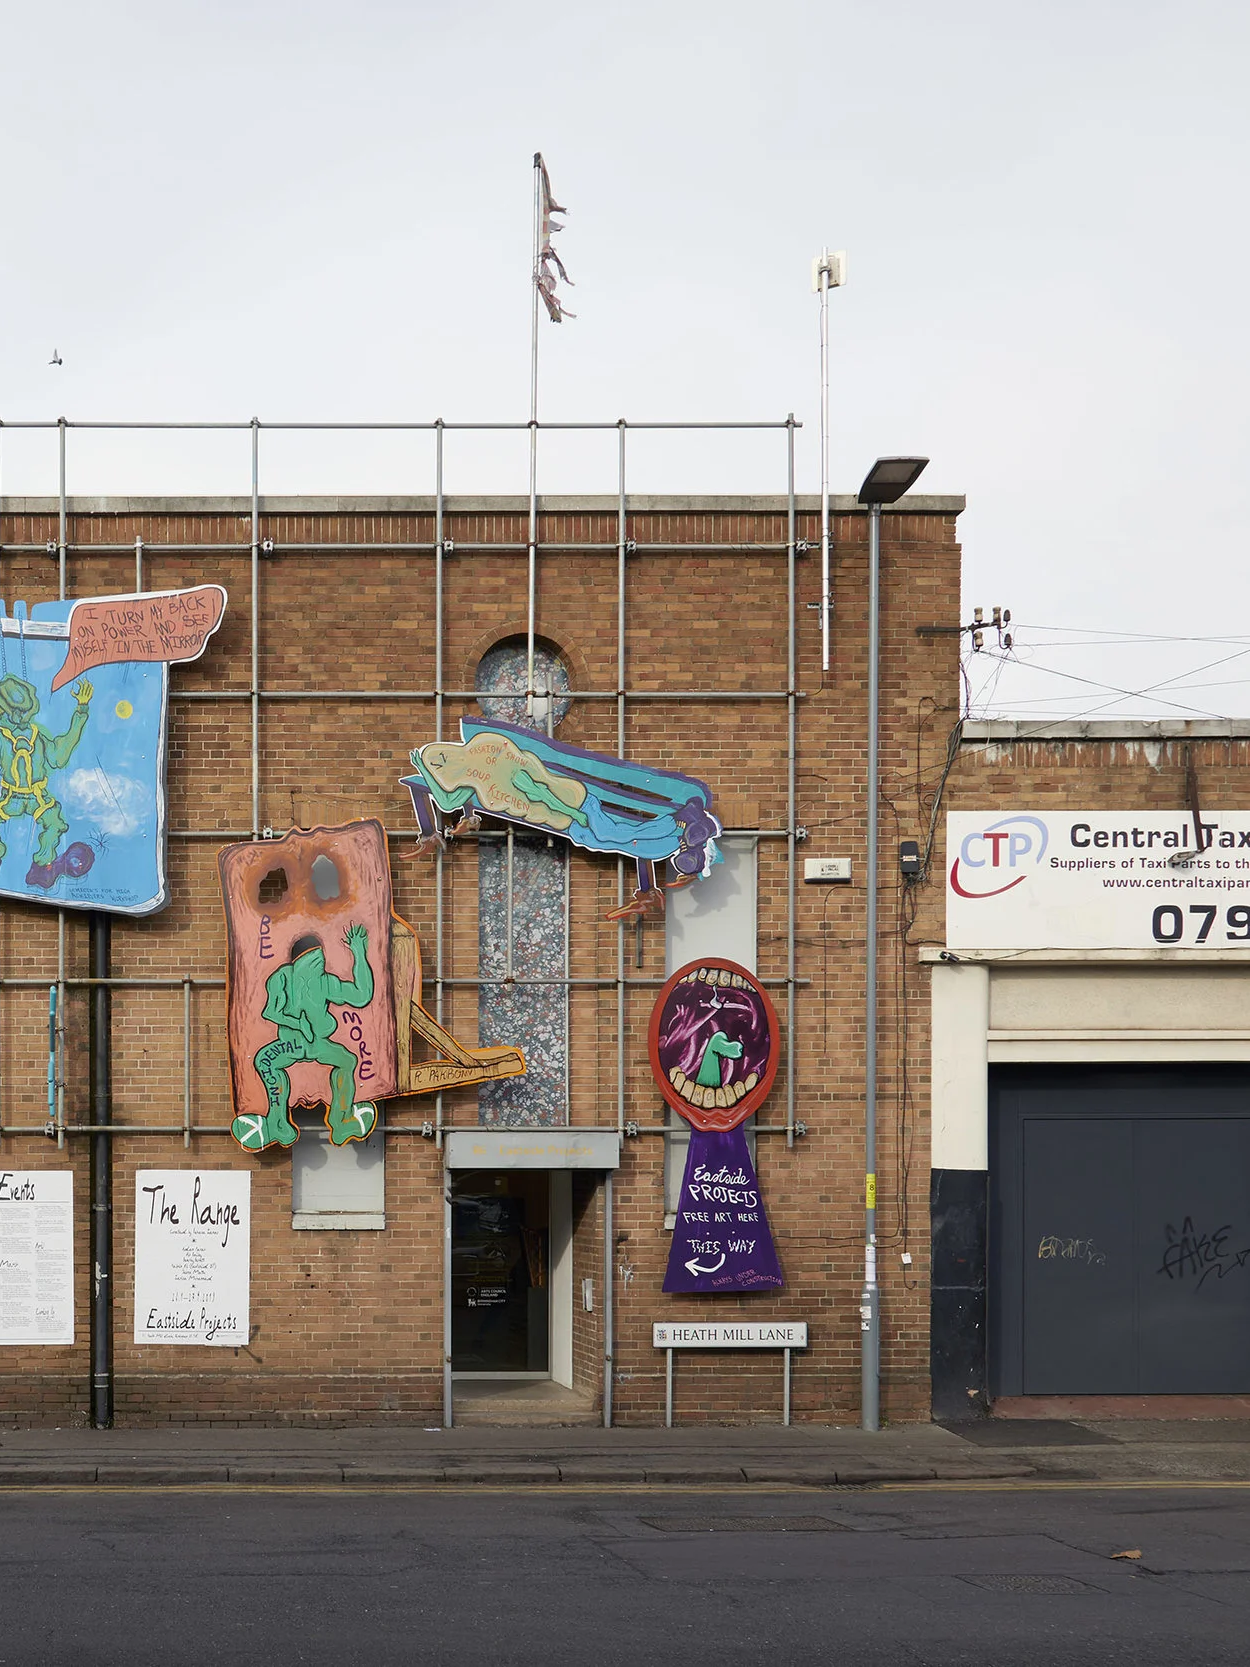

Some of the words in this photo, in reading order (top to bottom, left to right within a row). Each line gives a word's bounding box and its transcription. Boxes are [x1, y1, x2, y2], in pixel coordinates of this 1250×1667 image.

[85, 607, 98, 620] I
[107, 610, 144, 626] TURN
[150, 604, 163, 620] MY
[169, 597, 206, 615] BACK
[77, 625, 95, 638] ON
[101, 622, 147, 639] POWER
[153, 620, 176, 635] AND
[182, 613, 209, 627] SEE
[72, 639, 107, 659] MYSELF
[115, 640, 130, 654] IN
[133, 640, 158, 654] THE
[486, 757, 497, 765] OR
[505, 752, 528, 767] SHOW
[466, 768, 490, 782] SOUP
[487, 783, 530, 811] KITCHEN
[1070, 823, 1188, 848] Central
[960, 832, 1033, 868] CTP
[1050, 857, 1116, 872] Suppliers
[1121, 857, 1135, 869] of
[1139, 857, 1167, 869] Taxi
[1216, 859, 1230, 869] to
[1152, 905, 1250, 944] 079
[259, 914, 275, 960] BE
[342, 1011, 375, 1080] MORE
[694, 1164, 750, 1185] Eastside
[688, 1184, 758, 1208] PROJECTS
[142, 1185, 179, 1225] The
[191, 1176, 240, 1248] Range
[683, 1212, 710, 1223] FREE
[714, 1212, 732, 1222] ART
[738, 1212, 759, 1222] HERE
[686, 1239, 721, 1255] THIS
[727, 1239, 756, 1254] WAY
[146, 1308, 196, 1330] Eastside
[200, 1307, 237, 1341] Projects
[673, 1329, 717, 1340] HEATH
[722, 1329, 754, 1340] MILL
[759, 1329, 794, 1340] LANE
